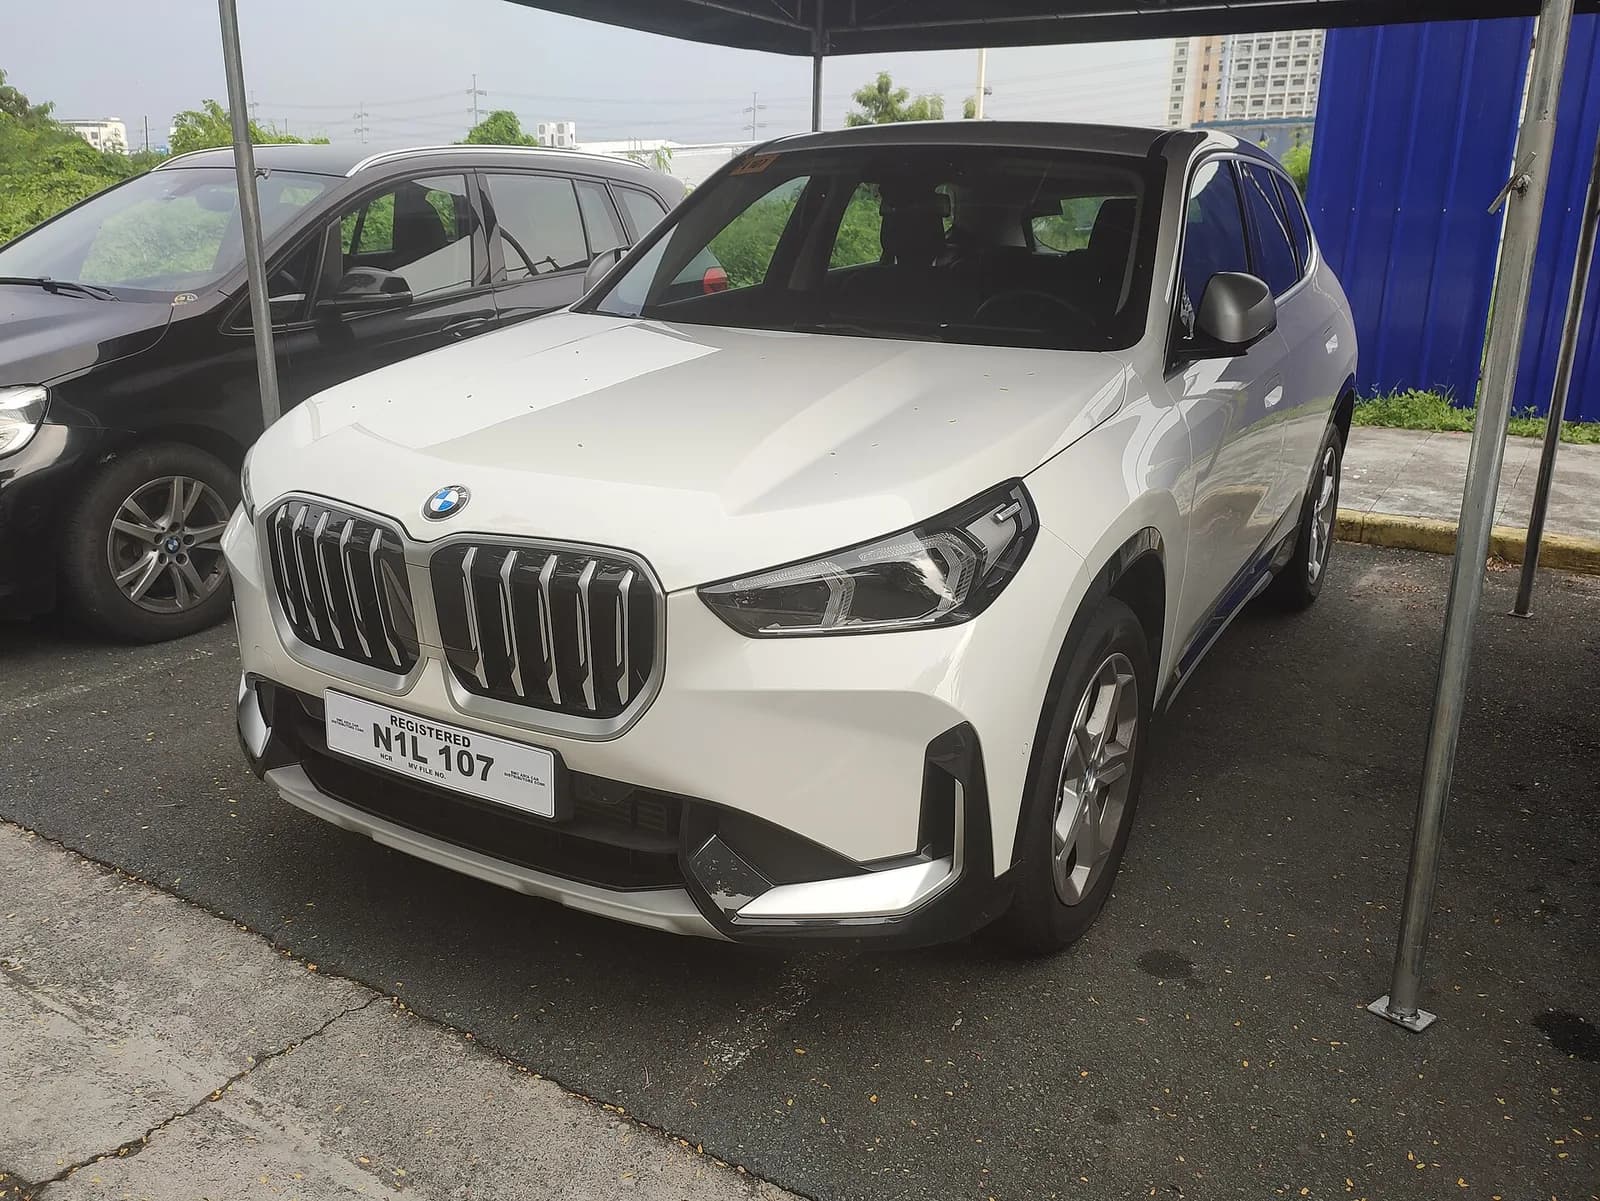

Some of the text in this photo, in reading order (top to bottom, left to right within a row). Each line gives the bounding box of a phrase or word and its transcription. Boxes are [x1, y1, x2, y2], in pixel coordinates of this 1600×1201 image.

[390, 715, 471, 748] REGISTERED
[373, 723, 494, 781] N1L 107
[380, 753, 393, 762] NCR
[408, 762, 446, 779] MV FILE NO.
